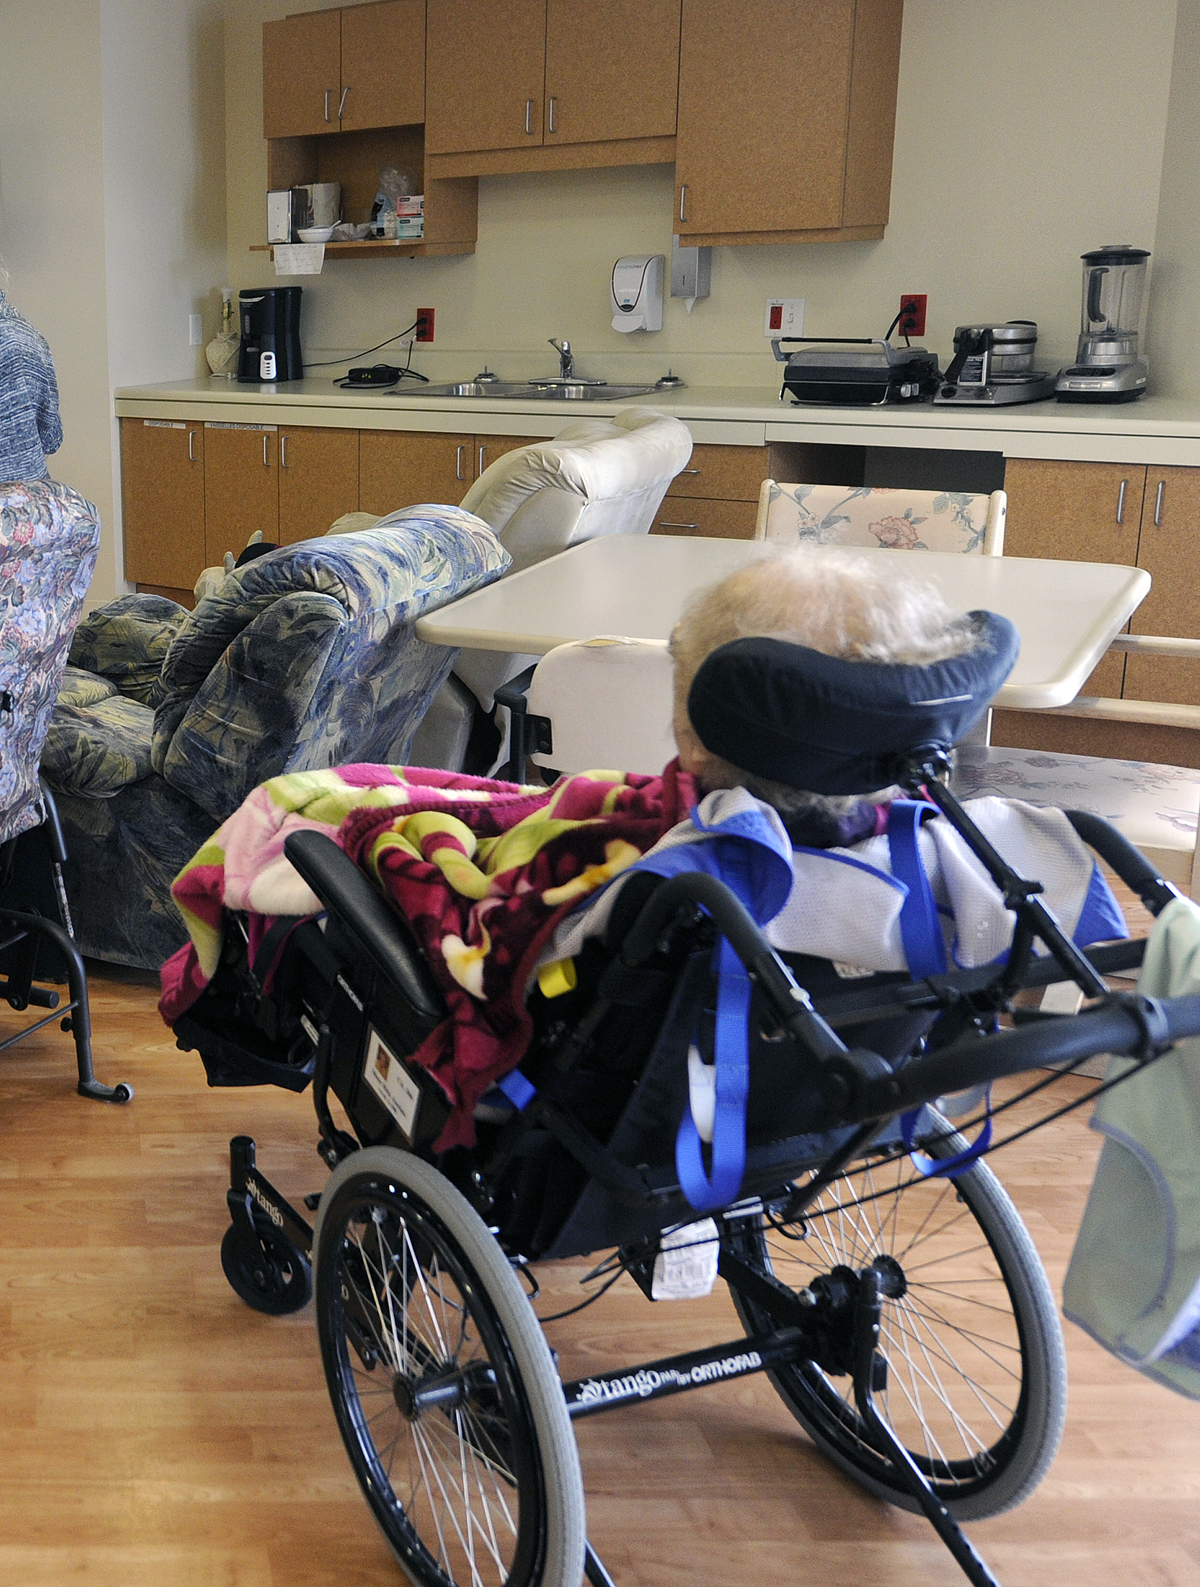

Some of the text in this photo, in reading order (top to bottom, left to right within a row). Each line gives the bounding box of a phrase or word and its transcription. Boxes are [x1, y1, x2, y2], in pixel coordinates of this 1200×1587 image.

[256, 1187, 284, 1228] tango
[601, 1368, 662, 1398] tango
[691, 1351, 763, 1384] ORTHOFAB
